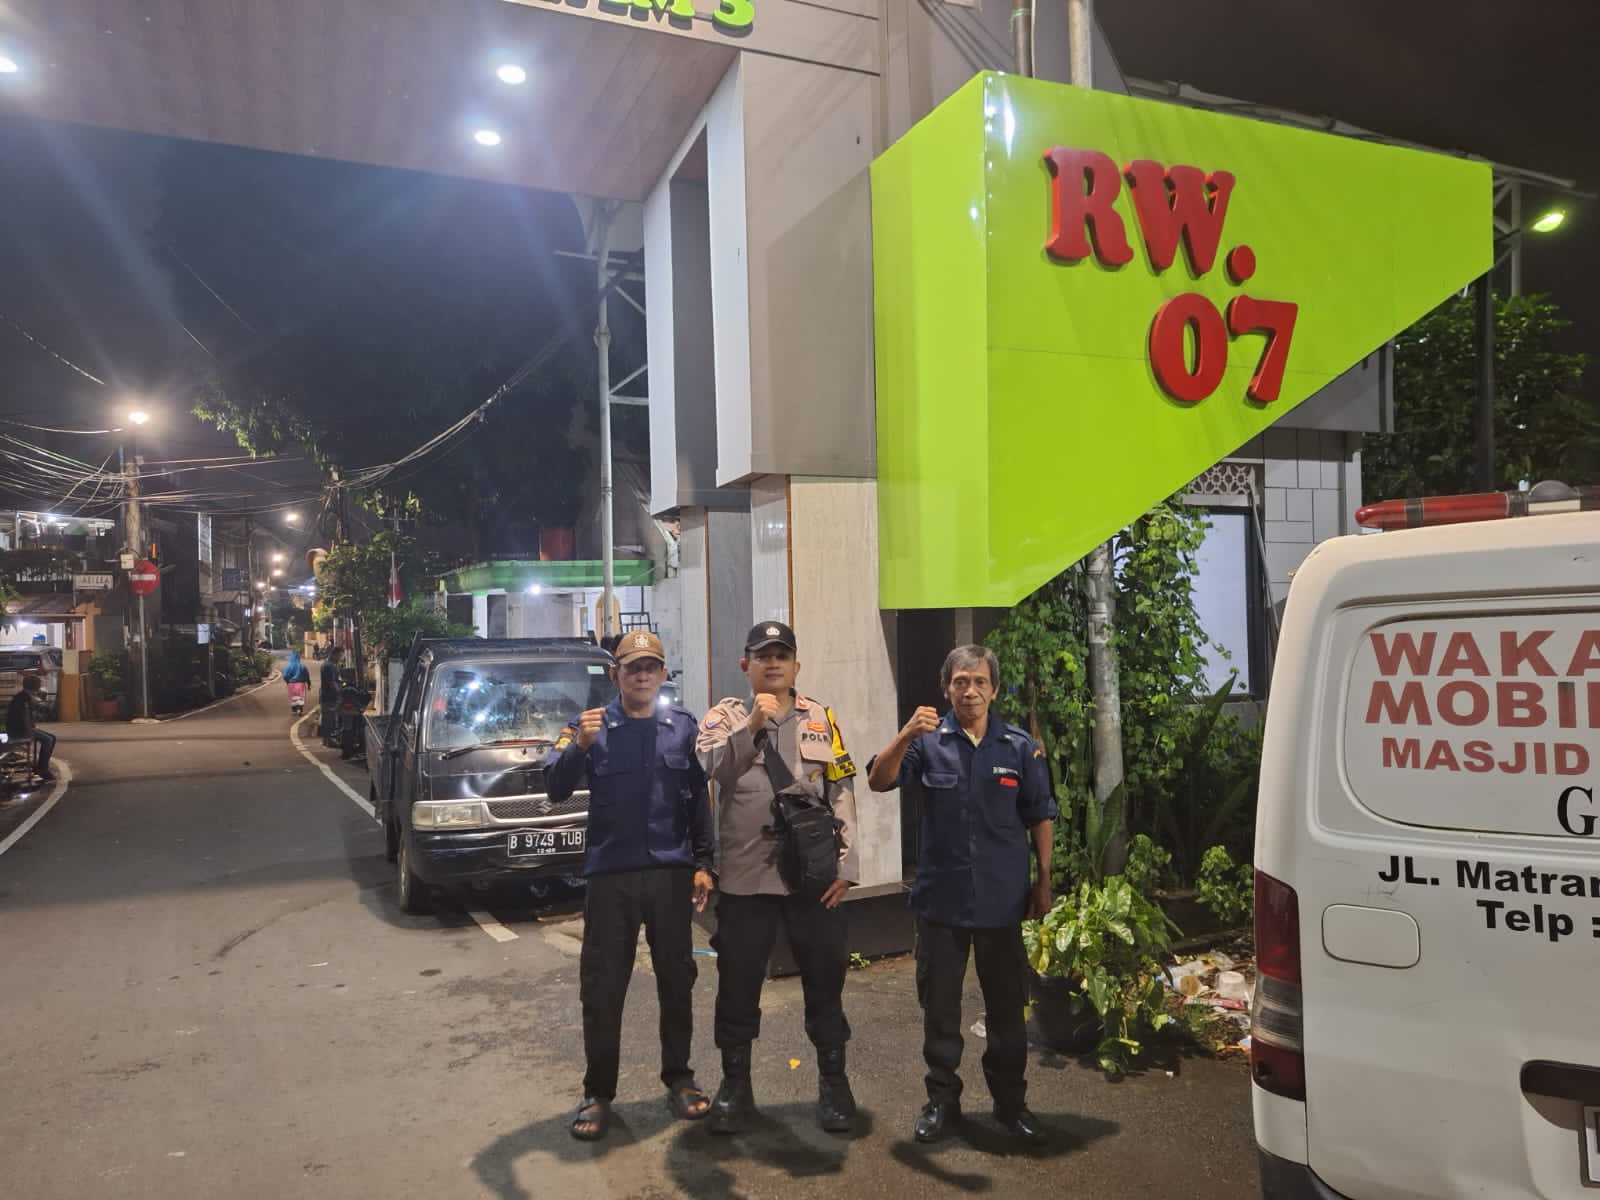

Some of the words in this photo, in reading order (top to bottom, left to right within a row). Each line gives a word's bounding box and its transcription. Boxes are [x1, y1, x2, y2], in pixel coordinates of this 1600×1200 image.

[1043, 147, 1256, 285] RW.
[1147, 292, 1299, 405] 07
[1370, 630, 1600, 676] WAKA
[1382, 737, 1590, 775] MASJID
[510, 835, 518, 849] B
[525, 831, 554, 847] 9749
[560, 831, 582, 846] TUB
[1378, 855, 1440, 886] JL.
[1476, 899, 1574, 942] Telp
